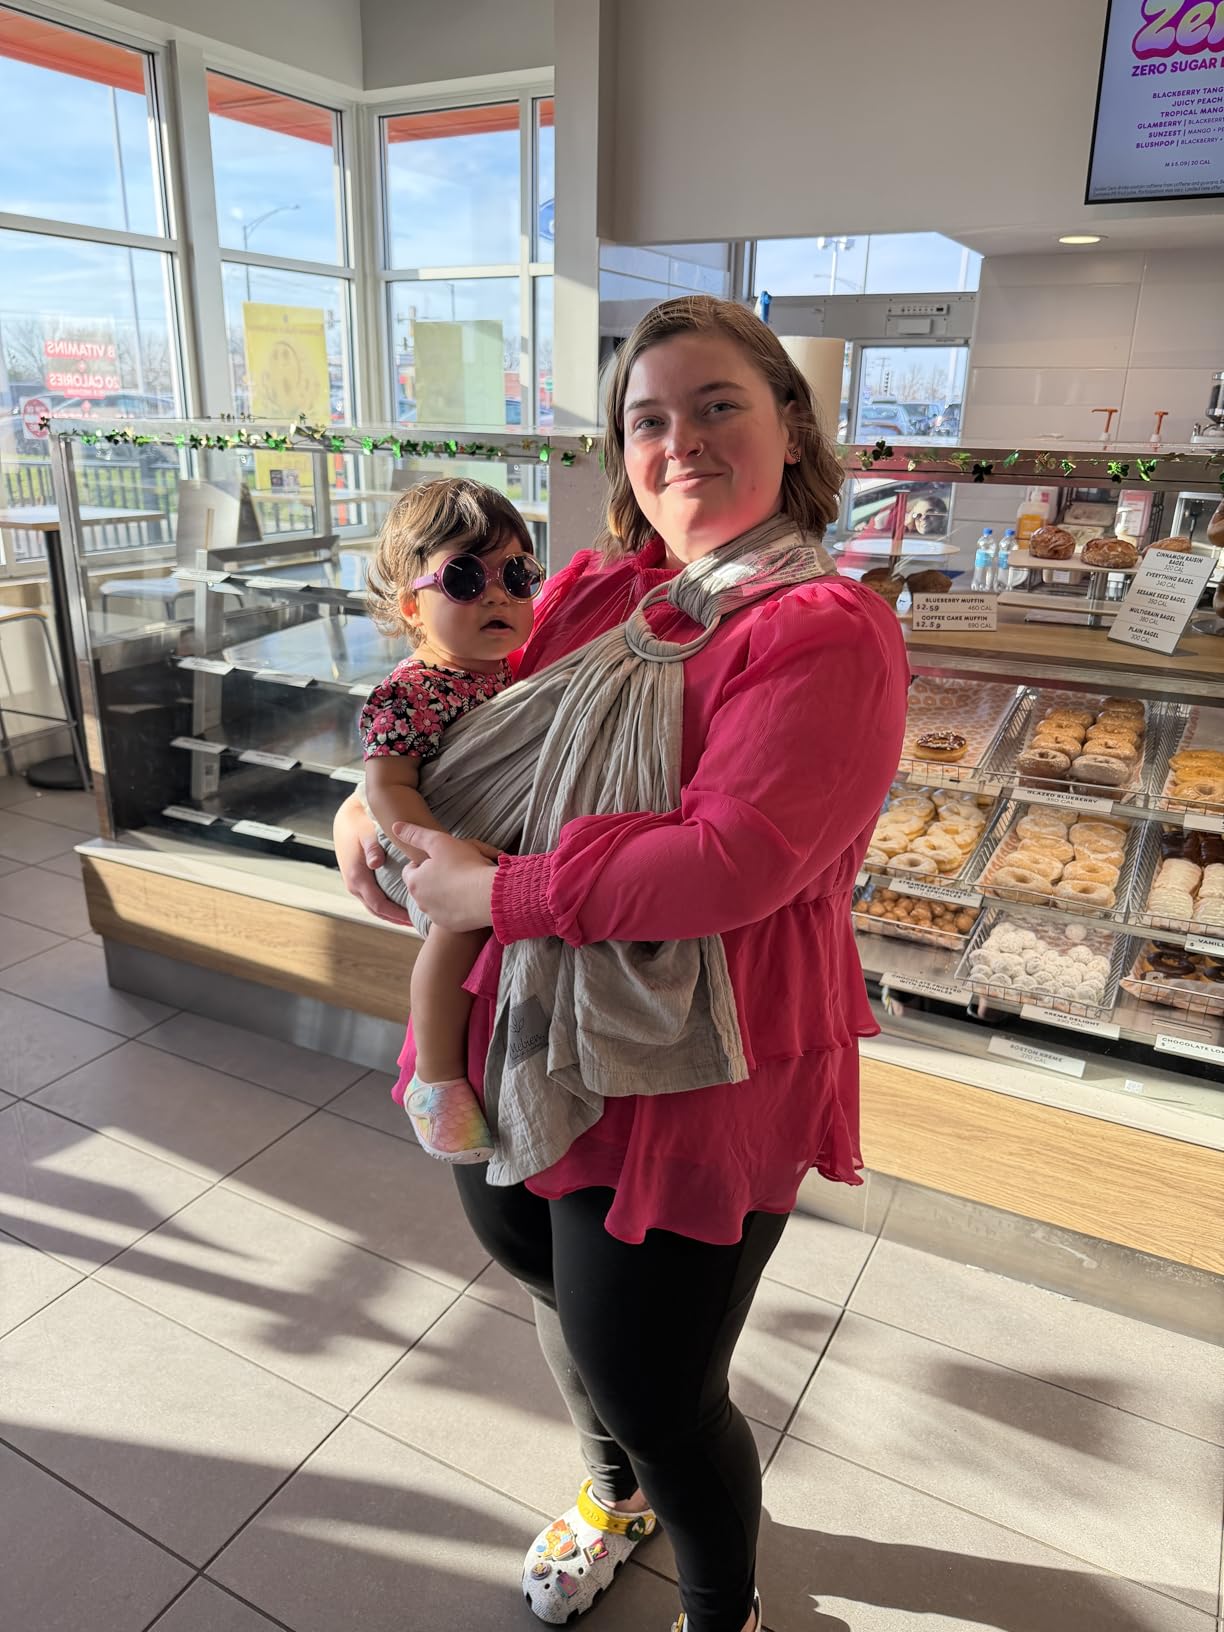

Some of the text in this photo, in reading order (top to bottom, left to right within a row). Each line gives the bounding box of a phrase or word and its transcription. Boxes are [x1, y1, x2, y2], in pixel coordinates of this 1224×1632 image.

[1131, 62, 1167, 77] ZERO
[1170, 57, 1218, 73] SUGAR
[1152, 88, 1201, 99] BLACKBERRY
[1171, 96, 1223, 107] JUICY PEACH
[1160, 109, 1198, 118] TROPICAL
[1137, 120, 1182, 130] GLAMBERRY
[1148, 130, 1181, 138] SUNZEST
[1135, 137, 1218, 148] BLUSHPOP BLACKBERRY
[1156, 551, 1203, 564] CINNAMON RAISIN
[1145, 571, 1194, 585] EVERYTHING BAGEL
[1136, 589, 1156, 597] SESAME
[1170, 595, 1186, 604] BAGEL
[1129, 607, 1176, 622] MULTIGRAIN BAGEL
[1128, 626, 1159, 639] PLAIN BAGEL
[1057, 795, 1098, 803] BLUEBERRY
[1069, 1017, 1100, 1026] DELIGHT
[1162, 1037, 1208, 1051] CHOCOLATE
[1010, 1044, 1038, 1056] BOSTON
